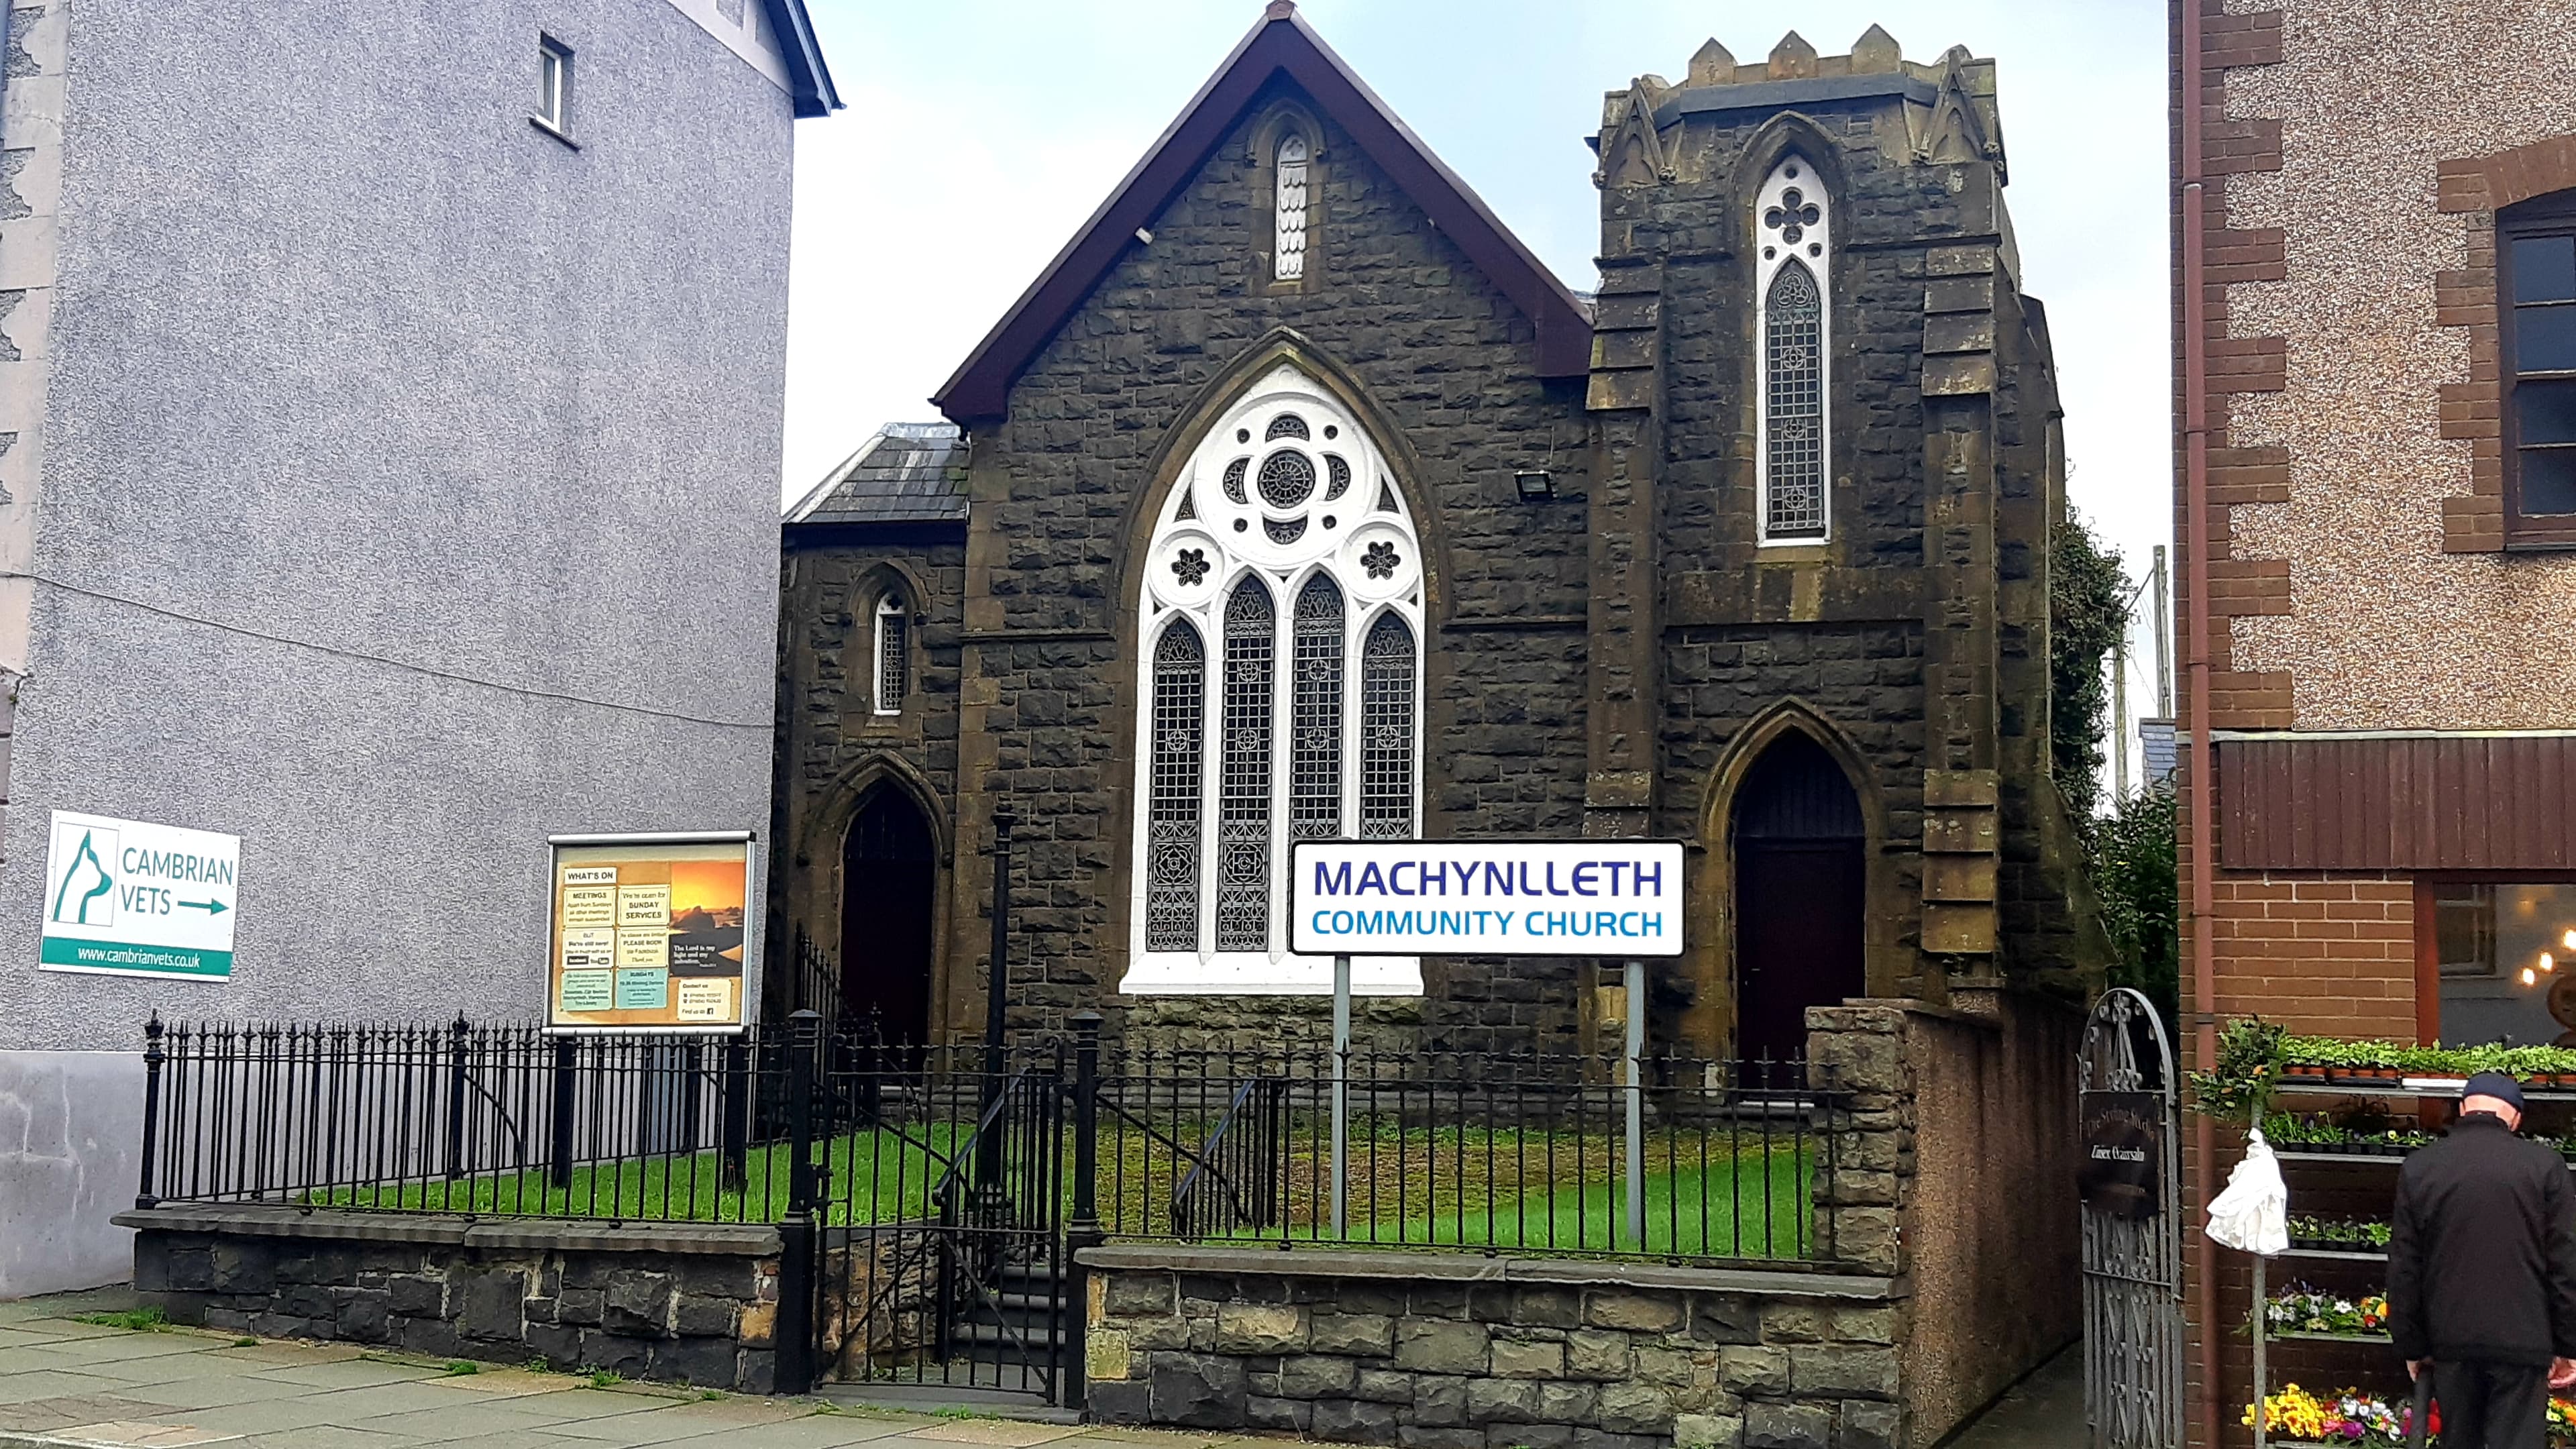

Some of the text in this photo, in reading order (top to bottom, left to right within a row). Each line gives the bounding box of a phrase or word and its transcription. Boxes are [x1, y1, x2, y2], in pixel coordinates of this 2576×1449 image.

[122, 847, 233, 885] CAMBRIAN
[568, 872, 599, 880] WHAT'S
[1314, 861, 1662, 897] MACHYNLLETH
[121, 884, 170, 915] VETS
[626, 911, 662, 919] SERVICES
[1312, 910, 1662, 937] COMMUNITY CHURCH
[78, 947, 200, 968] www.cambrianvets.co.uk
